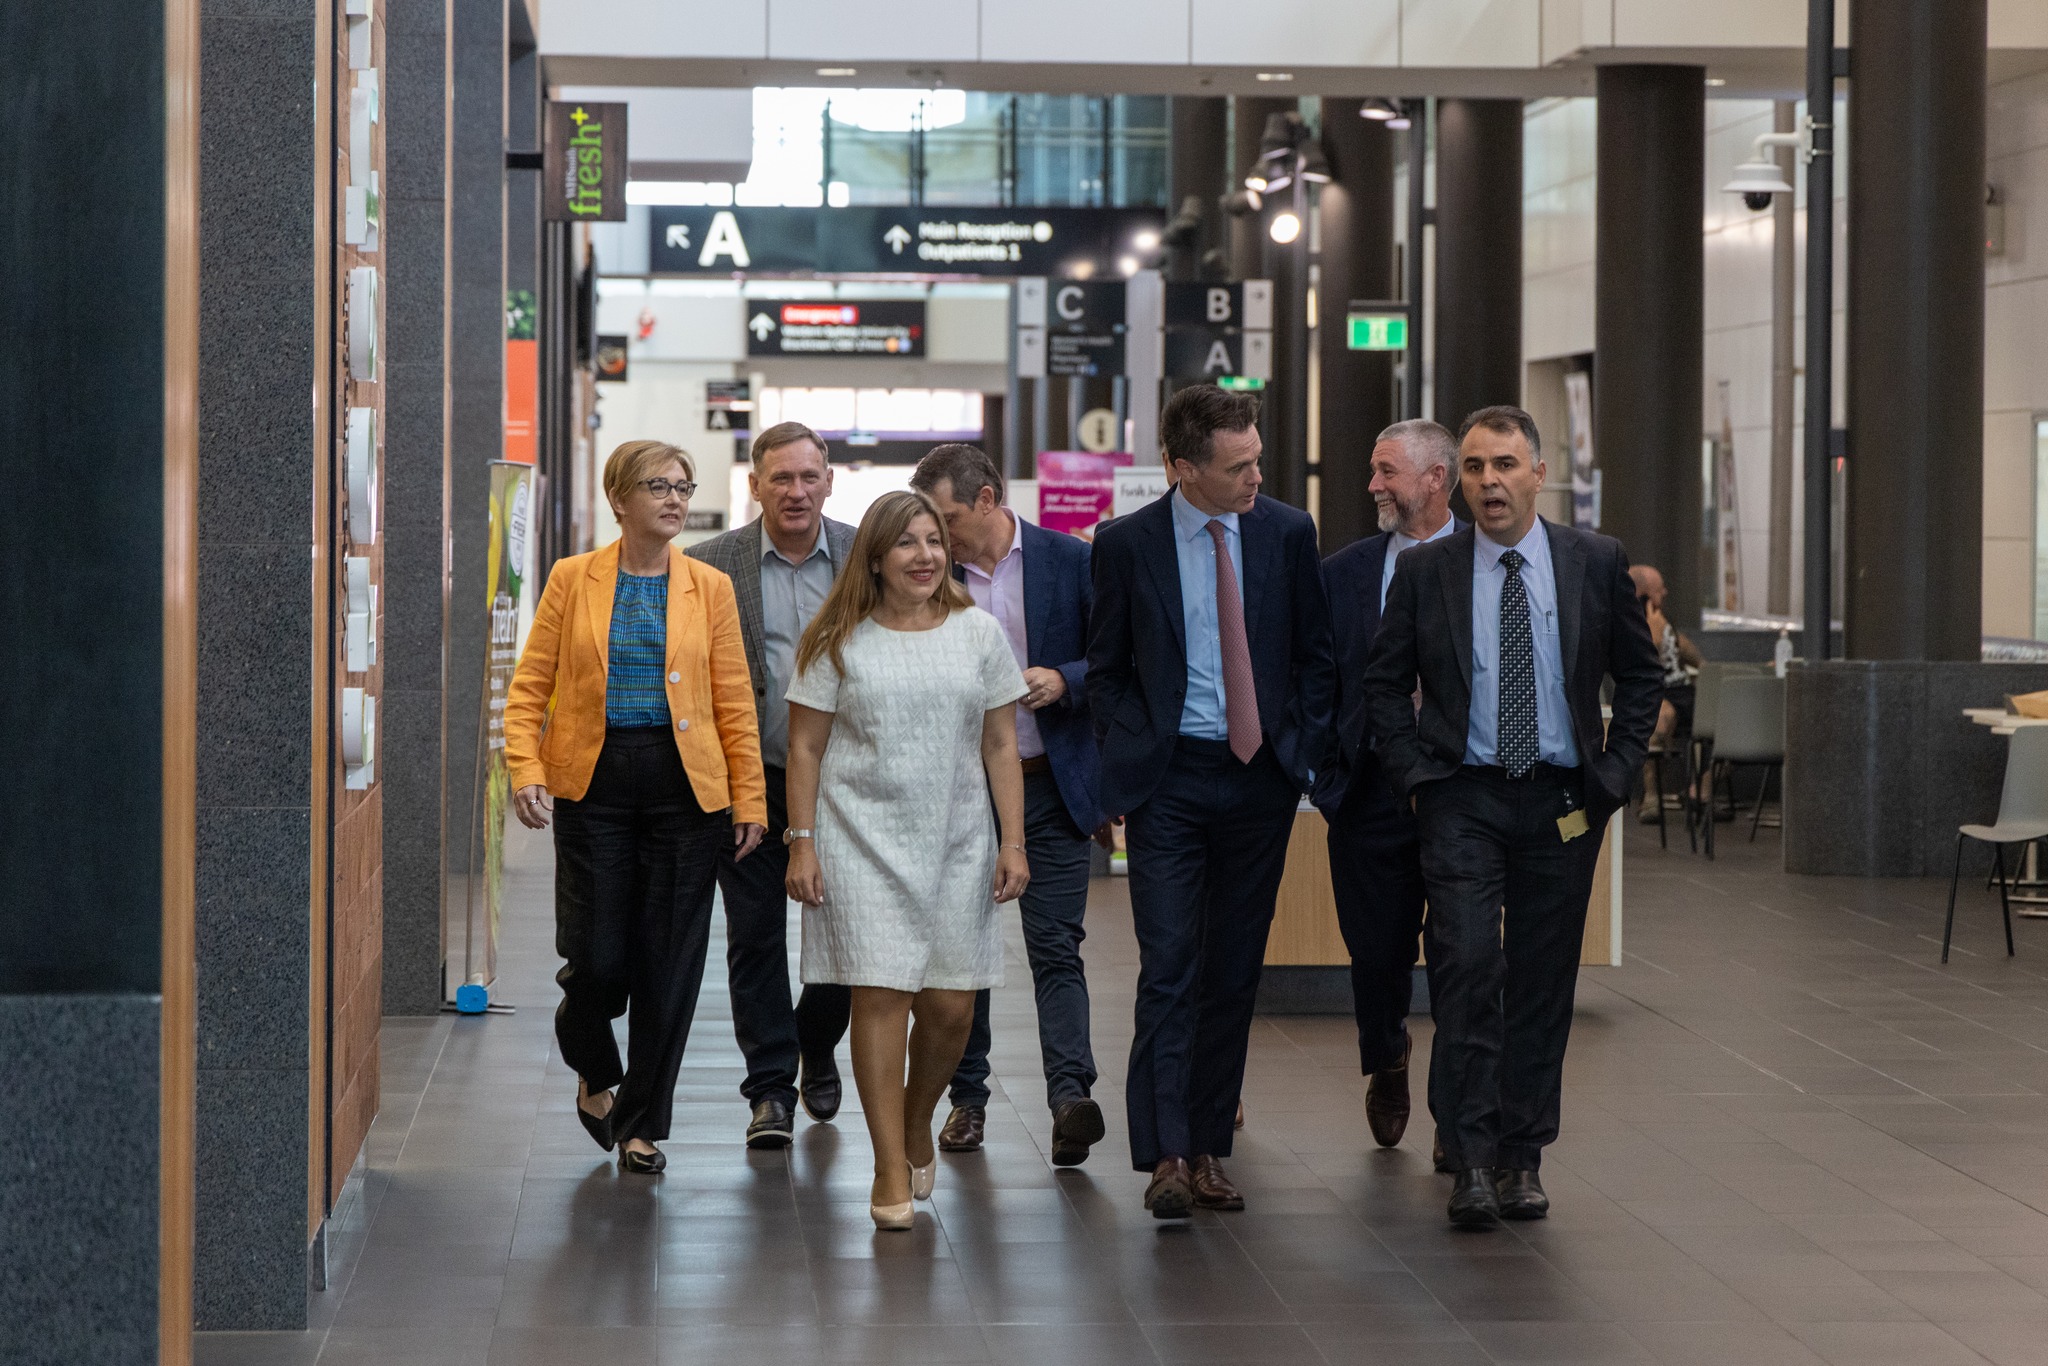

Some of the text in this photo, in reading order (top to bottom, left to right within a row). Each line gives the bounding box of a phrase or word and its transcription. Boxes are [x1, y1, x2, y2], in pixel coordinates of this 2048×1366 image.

[698, 211, 751, 267] A
[918, 221, 1033, 243] Main Reception
[917, 241, 1008, 264] Outpatients
[1056, 286, 1084, 320] C
[1206, 288, 1232, 322] B
[1203, 339, 1233, 374] A
